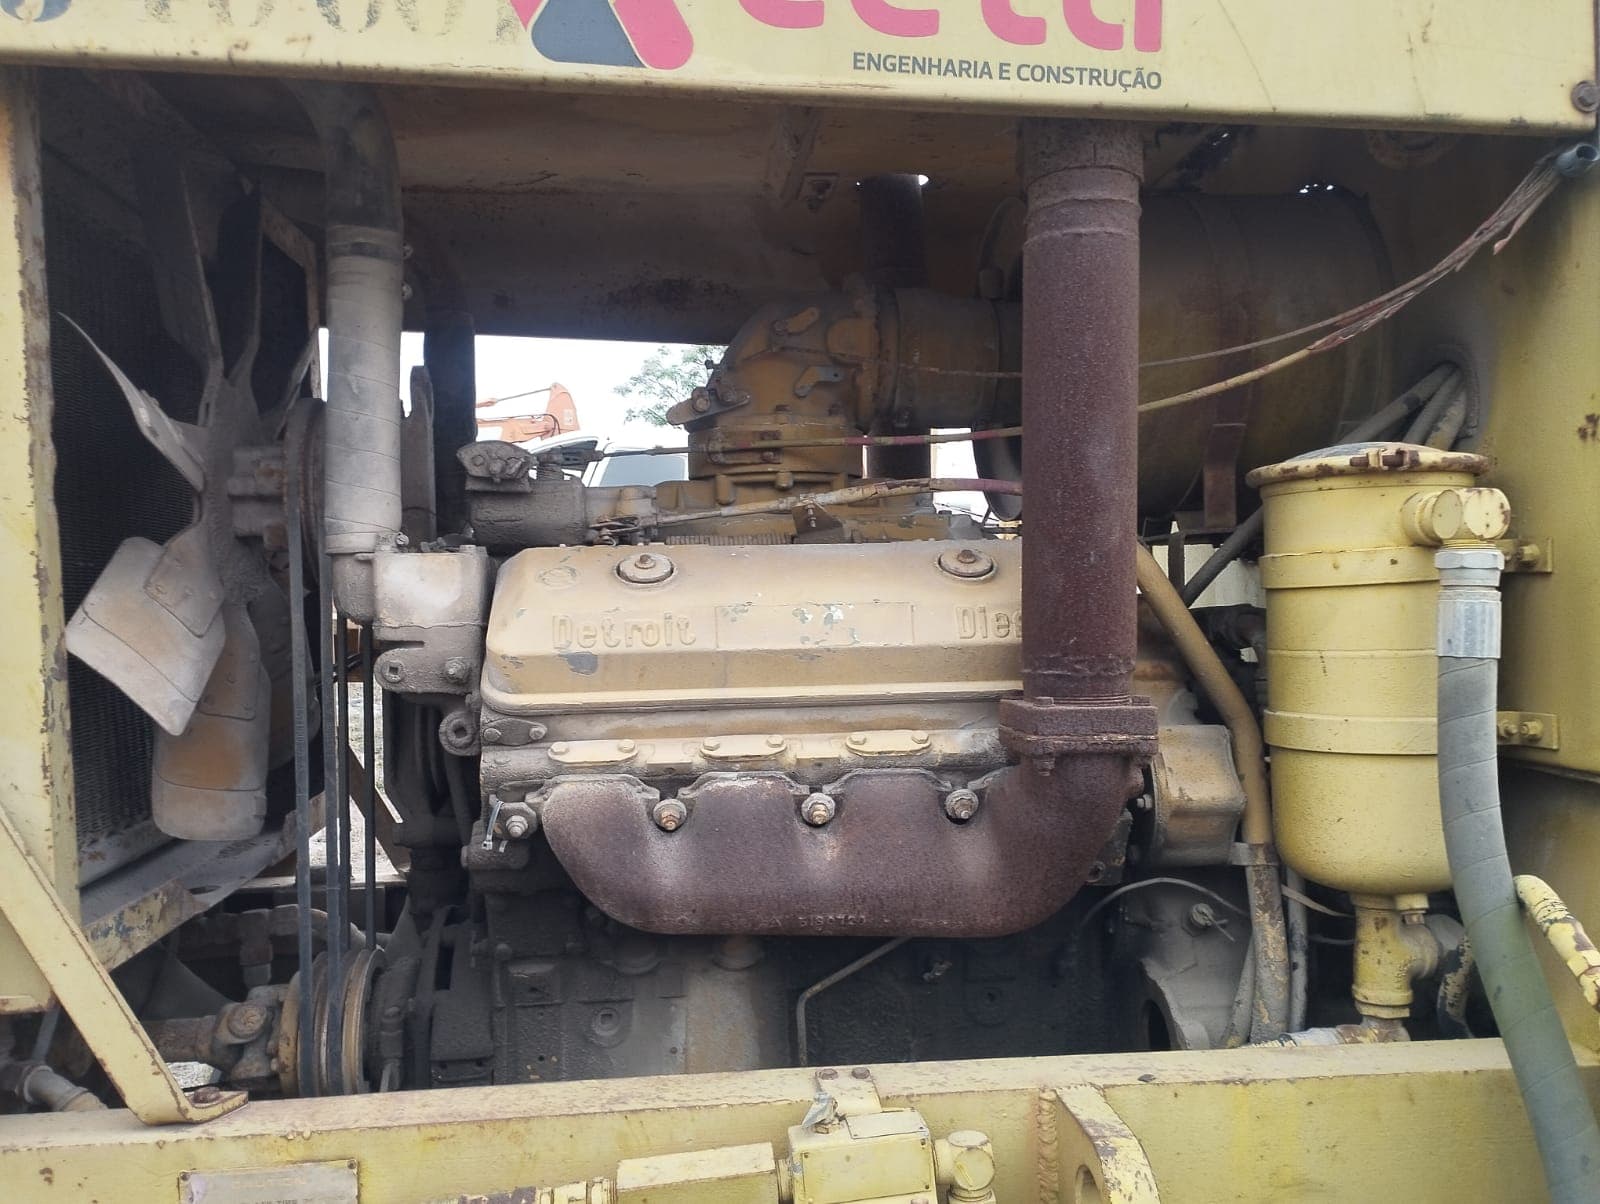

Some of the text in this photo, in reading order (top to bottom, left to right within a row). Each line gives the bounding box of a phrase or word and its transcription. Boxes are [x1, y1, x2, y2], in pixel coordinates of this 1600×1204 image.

[852, 52, 1162, 92] ENGENHARIA E CONSTRUÇÃO
[552, 610, 697, 650] Detroit
